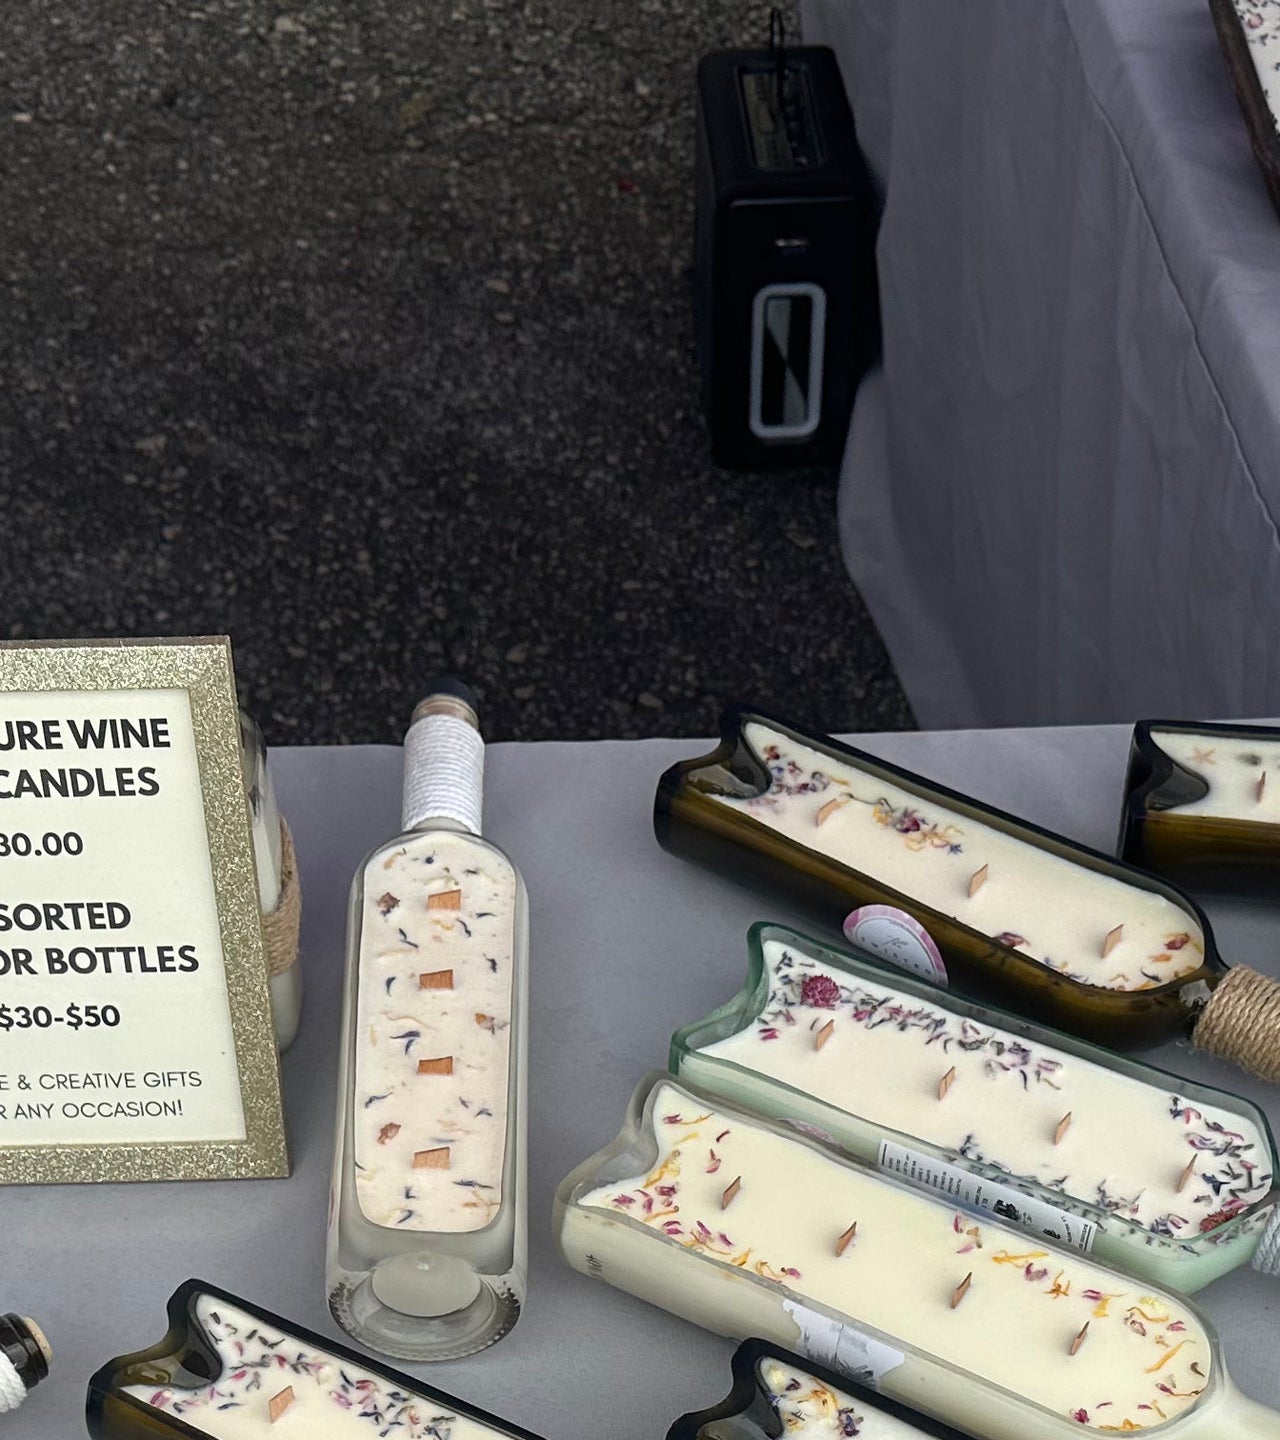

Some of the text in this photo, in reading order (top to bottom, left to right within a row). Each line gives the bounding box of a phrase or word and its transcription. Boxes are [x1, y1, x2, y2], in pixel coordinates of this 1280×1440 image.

[67, 718, 171, 749] WINE
[45, 945, 200, 975] BOTTLES
[17, 1075, 32, 1090] &
[38, 1073, 137, 1090] CREATIVE
[143, 1071, 203, 1088] GIFTS
[13, 1103, 55, 1119] ANY
[61, 1099, 184, 1118] OCCASION!
